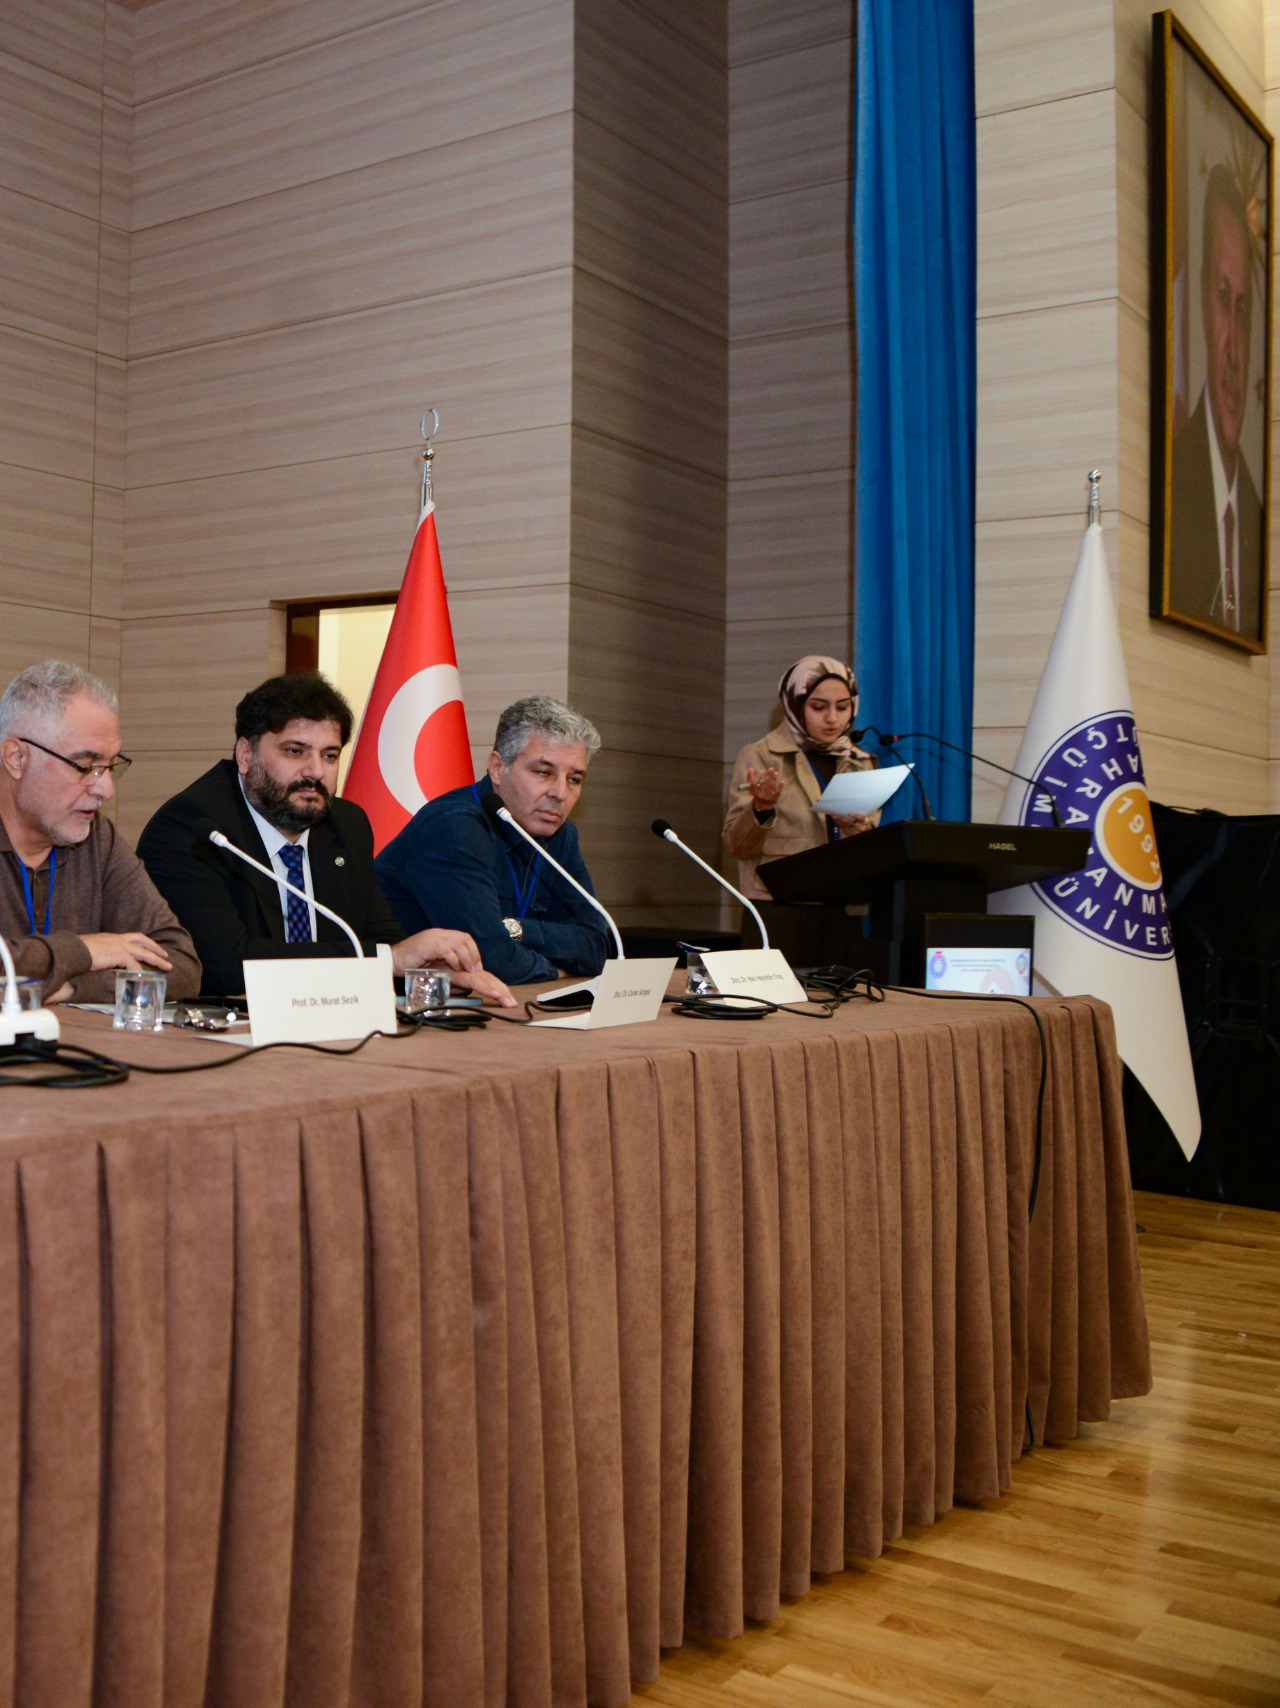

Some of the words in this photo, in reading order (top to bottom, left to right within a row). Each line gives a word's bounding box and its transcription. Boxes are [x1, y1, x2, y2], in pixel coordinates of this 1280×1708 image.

[291, 998, 308, 1008] Prof.
[309, 997, 320, 1007] Dr.
[320, 996, 340, 1006] Murat
[341, 995, 359, 1005] Sezik
